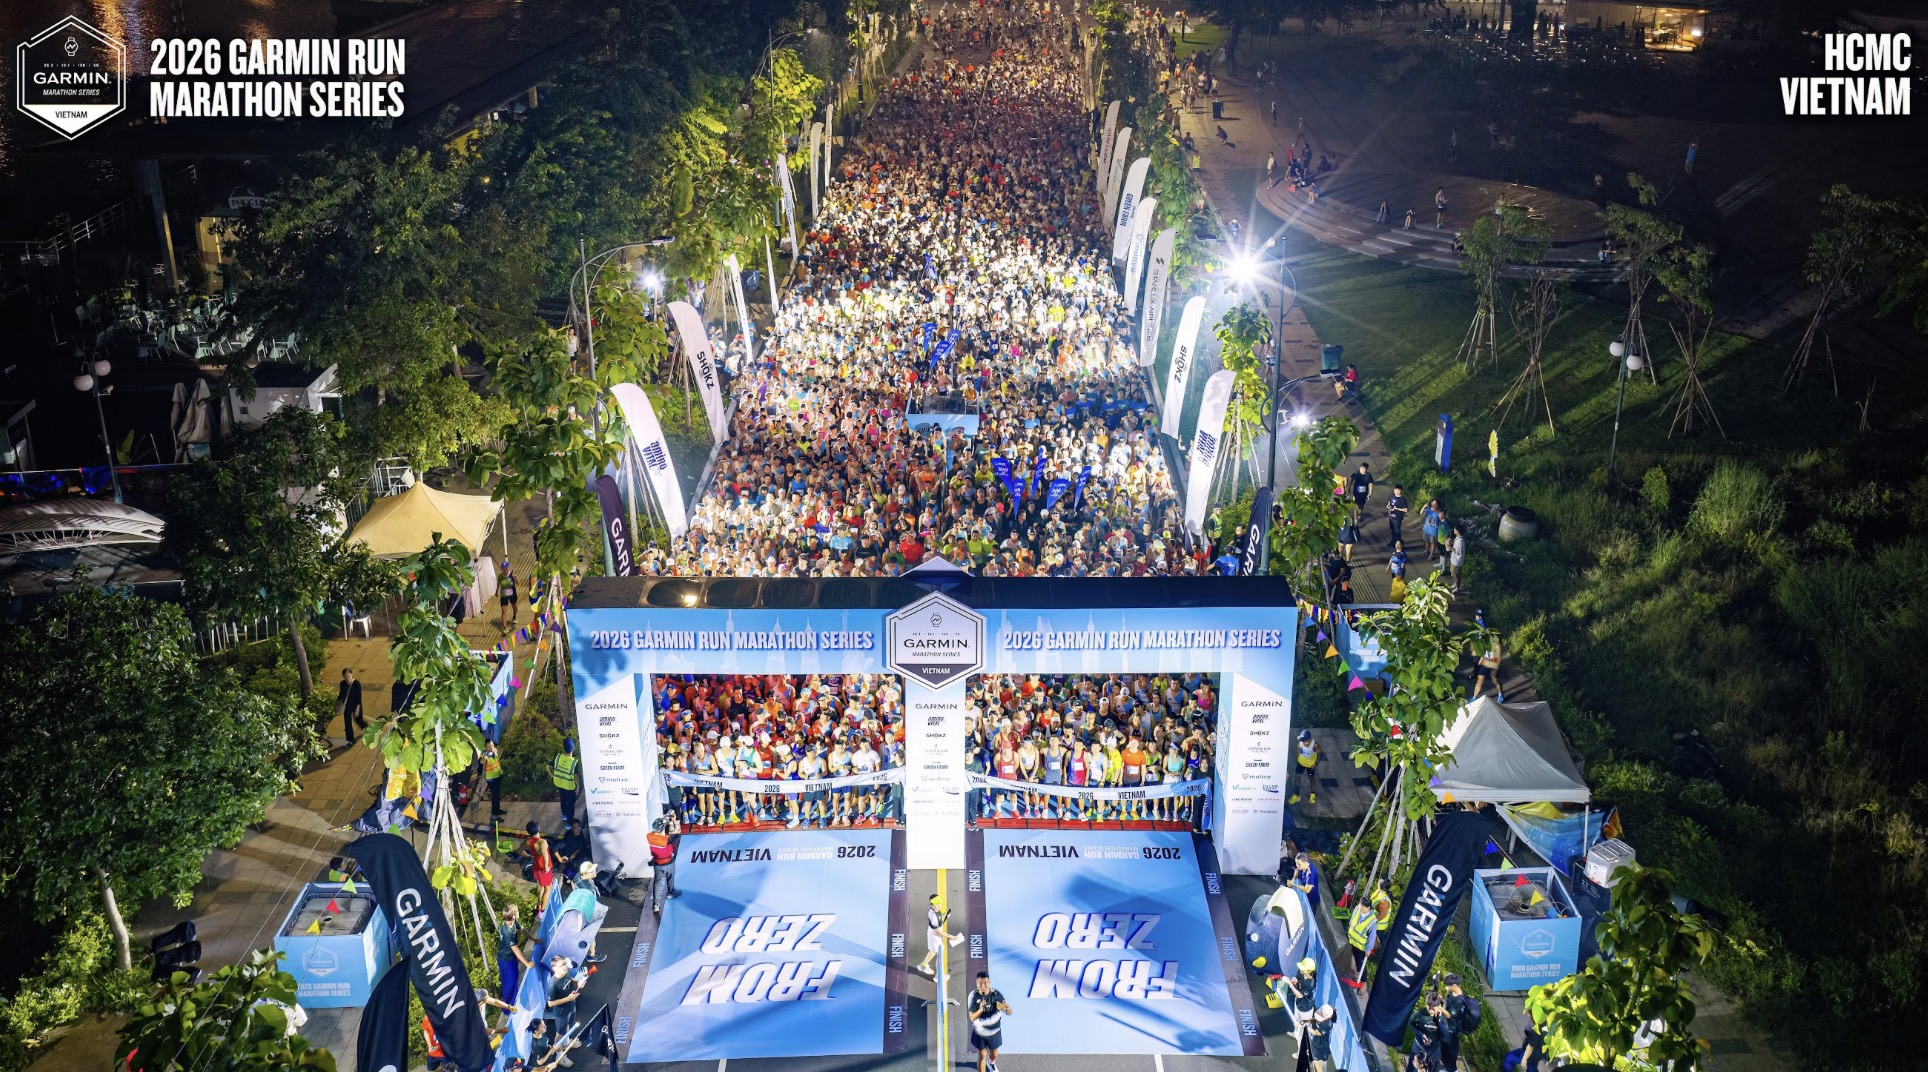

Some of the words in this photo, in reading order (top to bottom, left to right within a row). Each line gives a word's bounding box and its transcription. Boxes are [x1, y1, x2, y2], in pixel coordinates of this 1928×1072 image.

[696, 351, 714, 390] SHOKZ
[1174, 345, 1188, 384] SHOKZ
[590, 630, 630, 650] 2026
[633, 630, 696, 650] GARMIN
[699, 630, 731, 650] RUN
[734, 630, 819, 651] MARATHON
[820, 630, 875, 650] SERIES
[903, 638, 968, 649] GARMIN
[1003, 630, 1043, 650] 2026
[1045, 630, 1108, 650] GARMIN
[1109, 630, 1141, 650] RUN
[1143, 629, 1226, 649] MARATHON
[1228, 628, 1281, 649] SERIES
[1240, 700, 1283, 708] GARMIN
[764, 784, 781, 793] 2026
[805, 782, 833, 792] VIETNAM
[1078, 791, 1094, 800] 2026
[1118, 790, 1146, 800] VIETNAM
[1186, 785, 1201, 793] 2026
[691, 848, 772, 864] VIETNAM
[837, 845, 876, 858] 2026
[999, 845, 1079, 858] VIETNAM
[1144, 846, 1181, 859] 2026
[893, 868, 906, 891] FINISH
[969, 869, 981, 892] FINISH
[1204, 872, 1221, 895] FINISH
[700, 913, 837, 955] ZERO
[1032, 912, 1160, 949] ZERO
[1389, 864, 1452, 988] GARMIN
[396, 888, 465, 1019] GARMIN
[633, 943, 650, 968] FINISH
[892, 933, 905, 958] FINISH
[970, 934, 983, 959] FINISH
[1220, 936, 1237, 962] FINISH
[680, 960, 843, 1006] FROM
[1027, 959, 1181, 999] FROM
[615, 1016, 632, 1044] FINISH
[888, 1005, 903, 1033] FINISH
[1238, 1009, 1257, 1037] FINISH
